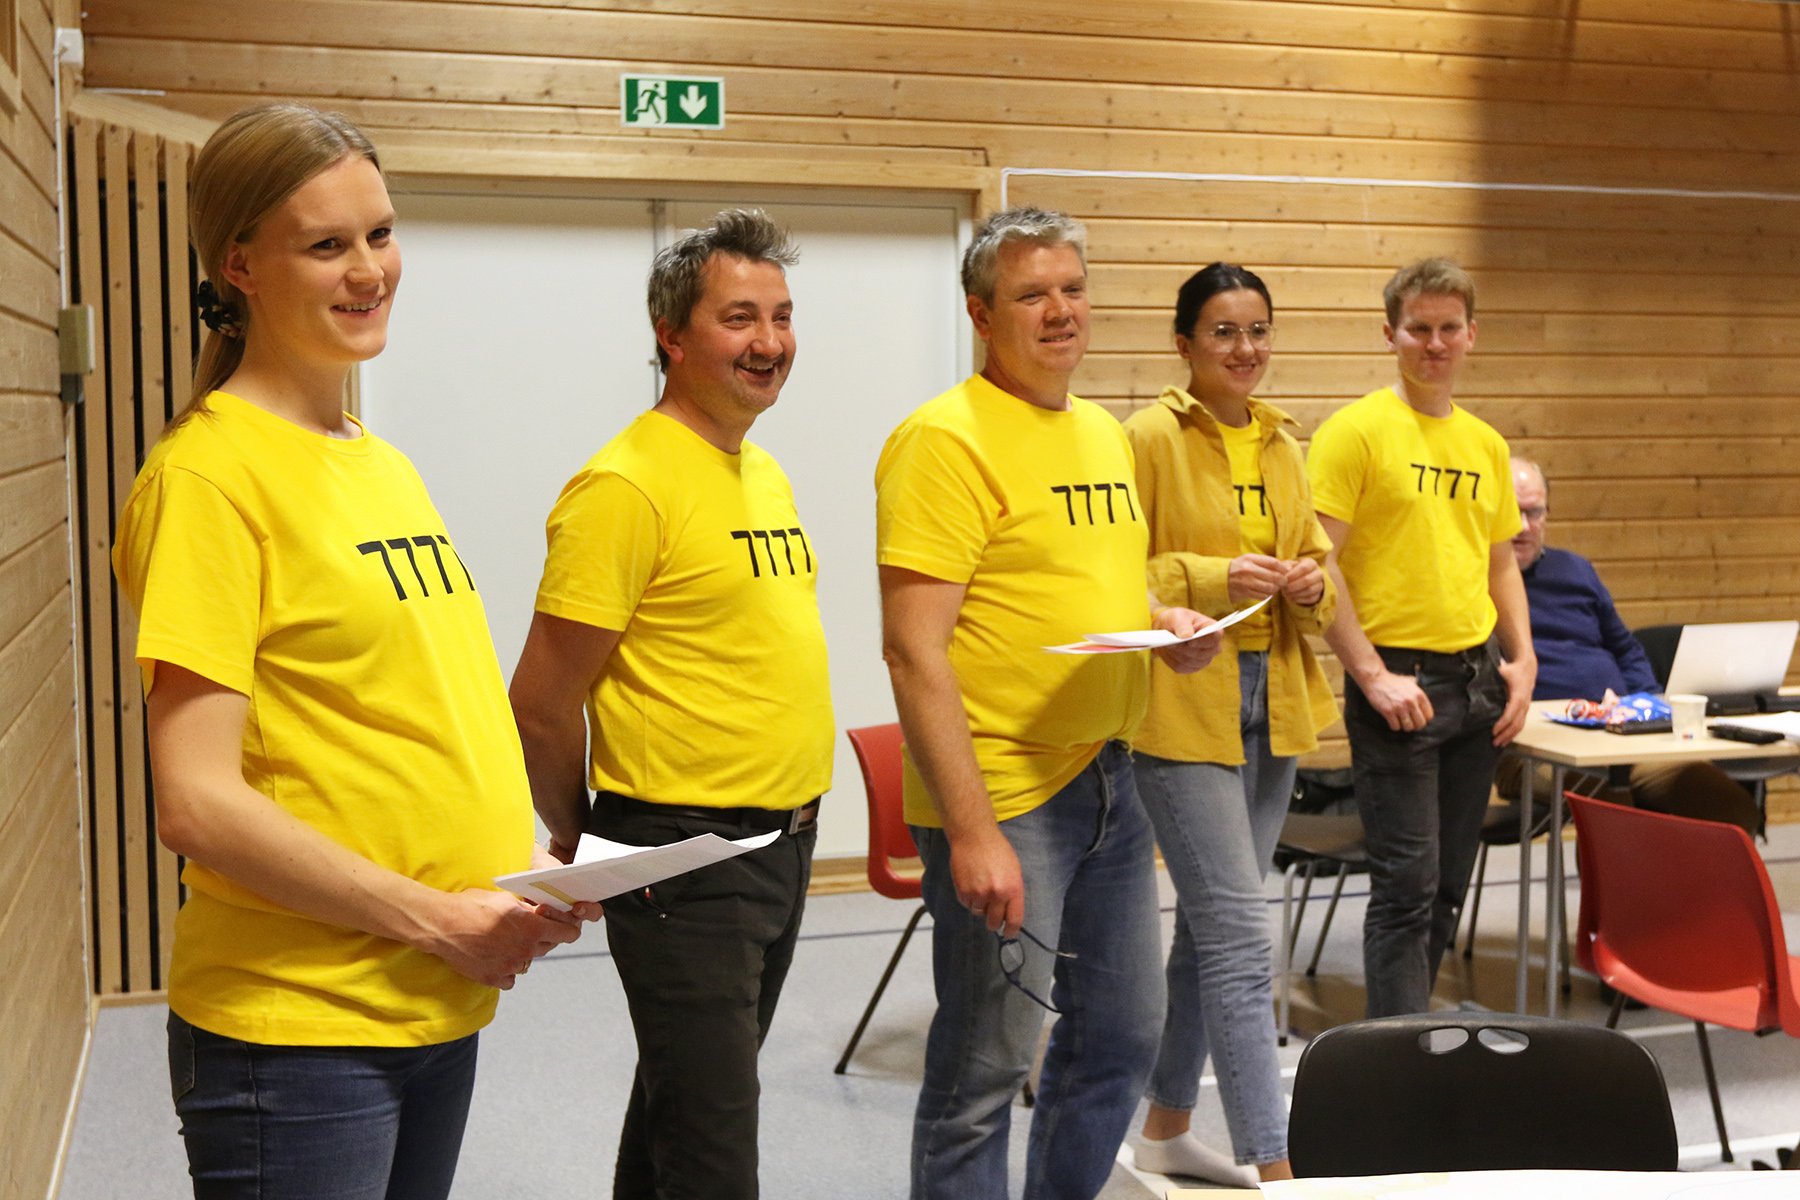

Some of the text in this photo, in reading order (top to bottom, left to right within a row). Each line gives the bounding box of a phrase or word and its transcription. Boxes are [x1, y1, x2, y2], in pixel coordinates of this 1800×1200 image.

[1410, 463, 1481, 500] 7777
[1050, 482, 1136, 525] 7777
[730, 527, 811, 578] 7777
